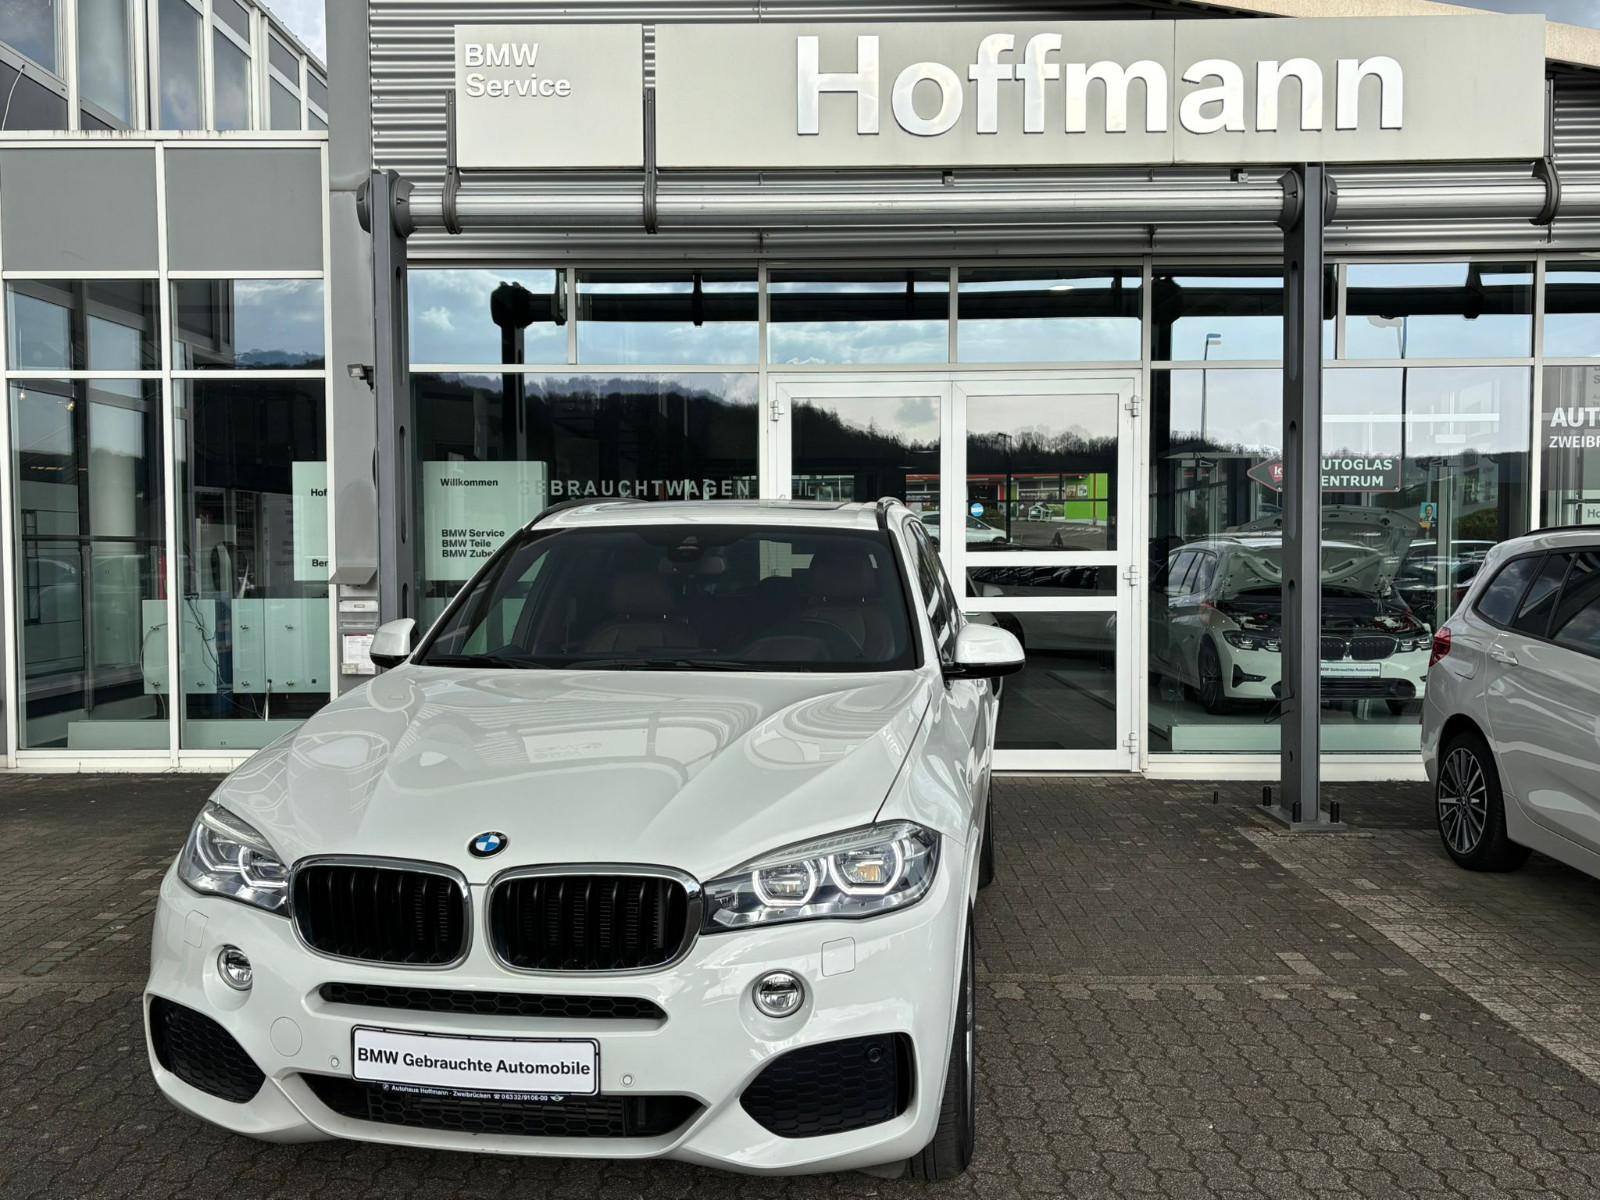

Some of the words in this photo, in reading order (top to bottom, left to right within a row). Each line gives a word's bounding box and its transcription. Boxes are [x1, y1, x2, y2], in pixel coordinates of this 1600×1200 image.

[464, 42, 539, 67] BMW
[465, 72, 571, 97] Service
[797, 33, 1404, 136] Hoffmann
[1550, 407, 1600, 427] AUT
[440, 478, 499, 487] Willkommen
[441, 529, 467, 538] BMW
[469, 528, 505, 538] Service
[442, 539, 468, 548] BMW
[470, 539, 492, 548] Teile
[442, 549, 468, 558] BMW
[470, 549, 496, 558] Zube
[357, 1048, 399, 1066] BMW
[402, 1053, 492, 1072] Gebrauchte
[496, 1059, 591, 1076] Automobile
[391, 1085, 419, 1093] Autohaus
